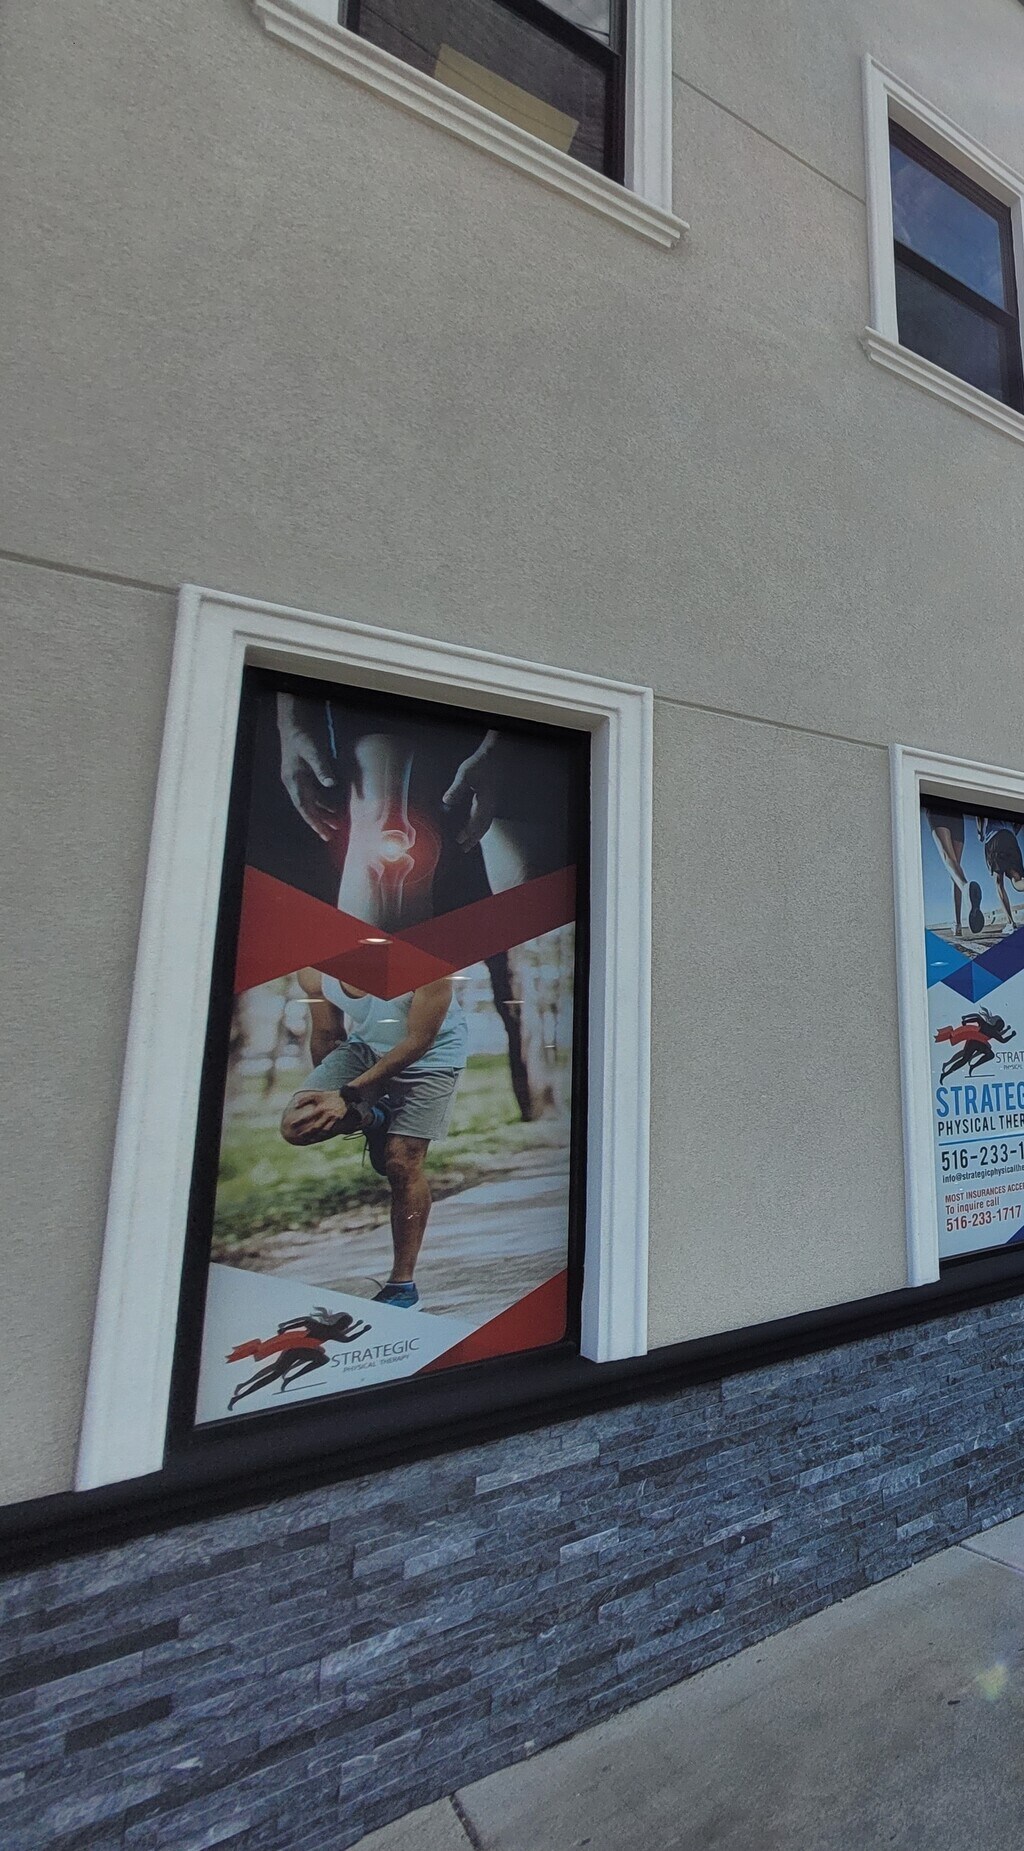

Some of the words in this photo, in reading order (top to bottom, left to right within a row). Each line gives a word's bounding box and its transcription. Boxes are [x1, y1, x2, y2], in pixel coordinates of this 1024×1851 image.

[938, 1116, 996, 1137] PHYSICAL
[945, 1192, 965, 1203] MOST
[966, 1185, 1006, 1199] INSURANCES
[946, 1205, 955, 1215] To
[957, 1201, 984, 1213] inquire
[986, 1197, 1000, 1208] call
[946, 1205, 1022, 1232] 516-233-1717
[331, 1337, 420, 1368] STRATEGIC
[343, 1361, 376, 1372] PHYSICAL
[379, 1354, 410, 1365] THERAPY
